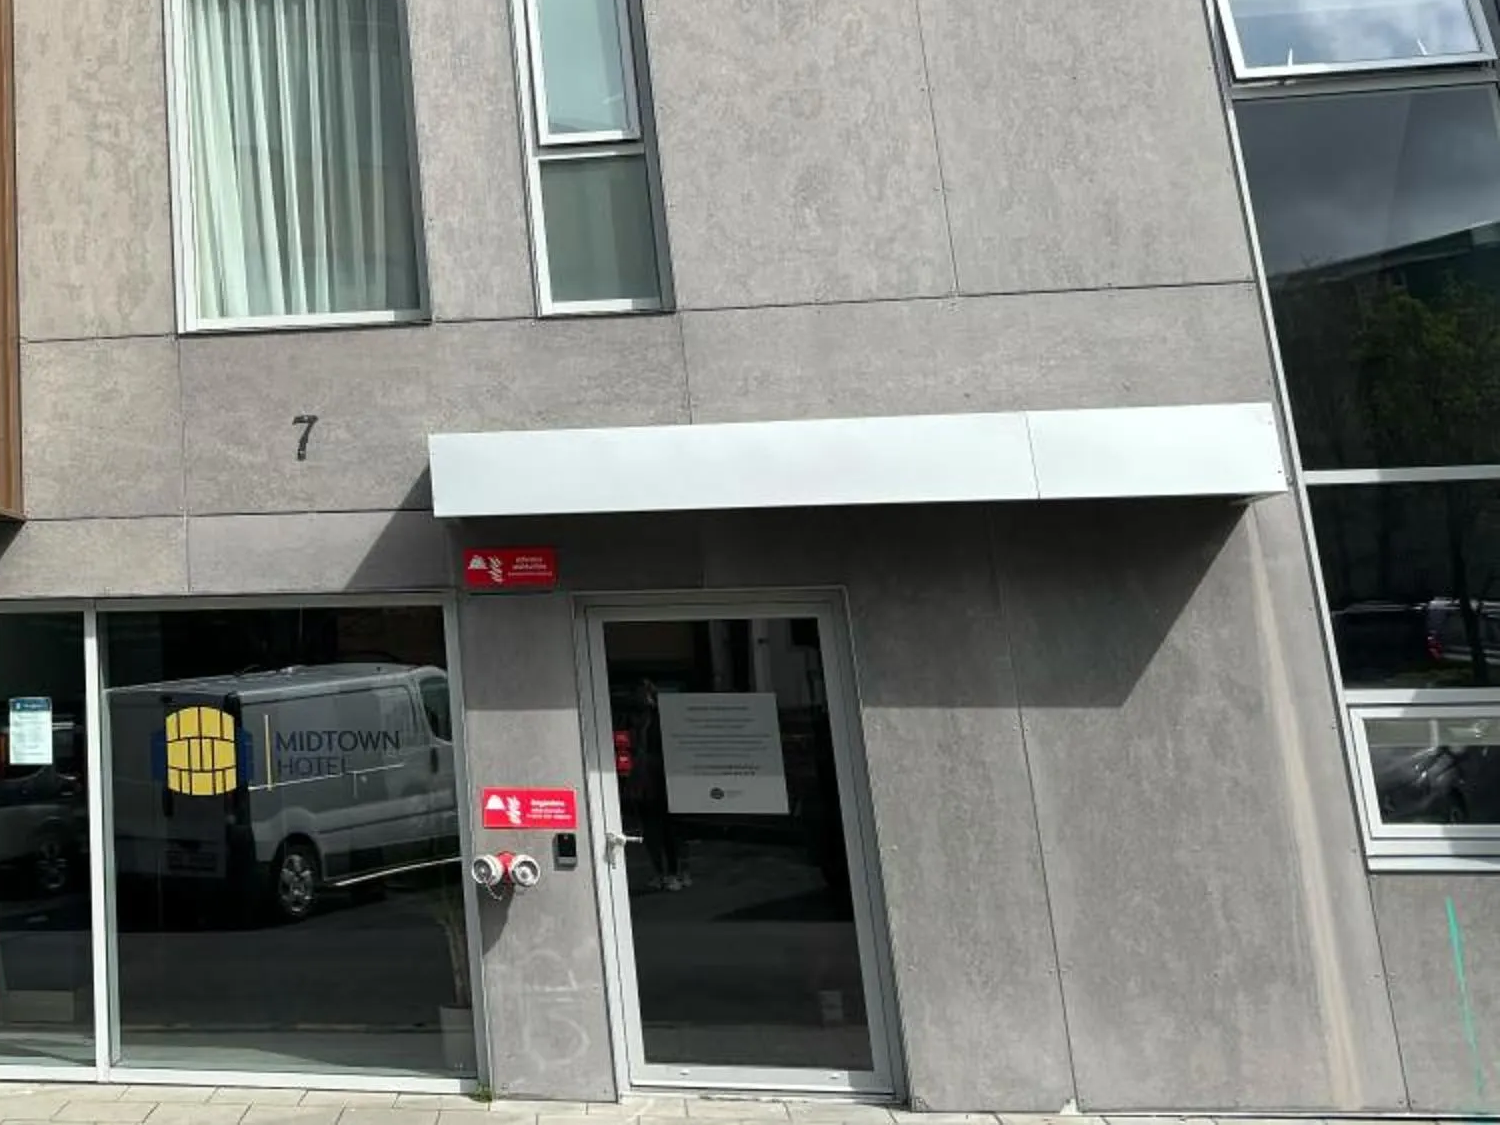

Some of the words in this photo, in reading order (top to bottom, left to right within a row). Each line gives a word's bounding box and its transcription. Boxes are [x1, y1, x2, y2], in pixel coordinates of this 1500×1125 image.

[291, 414, 319, 462] 7
[275, 730, 401, 752] MIDTOWN
[277, 756, 349, 776] HOTEL
